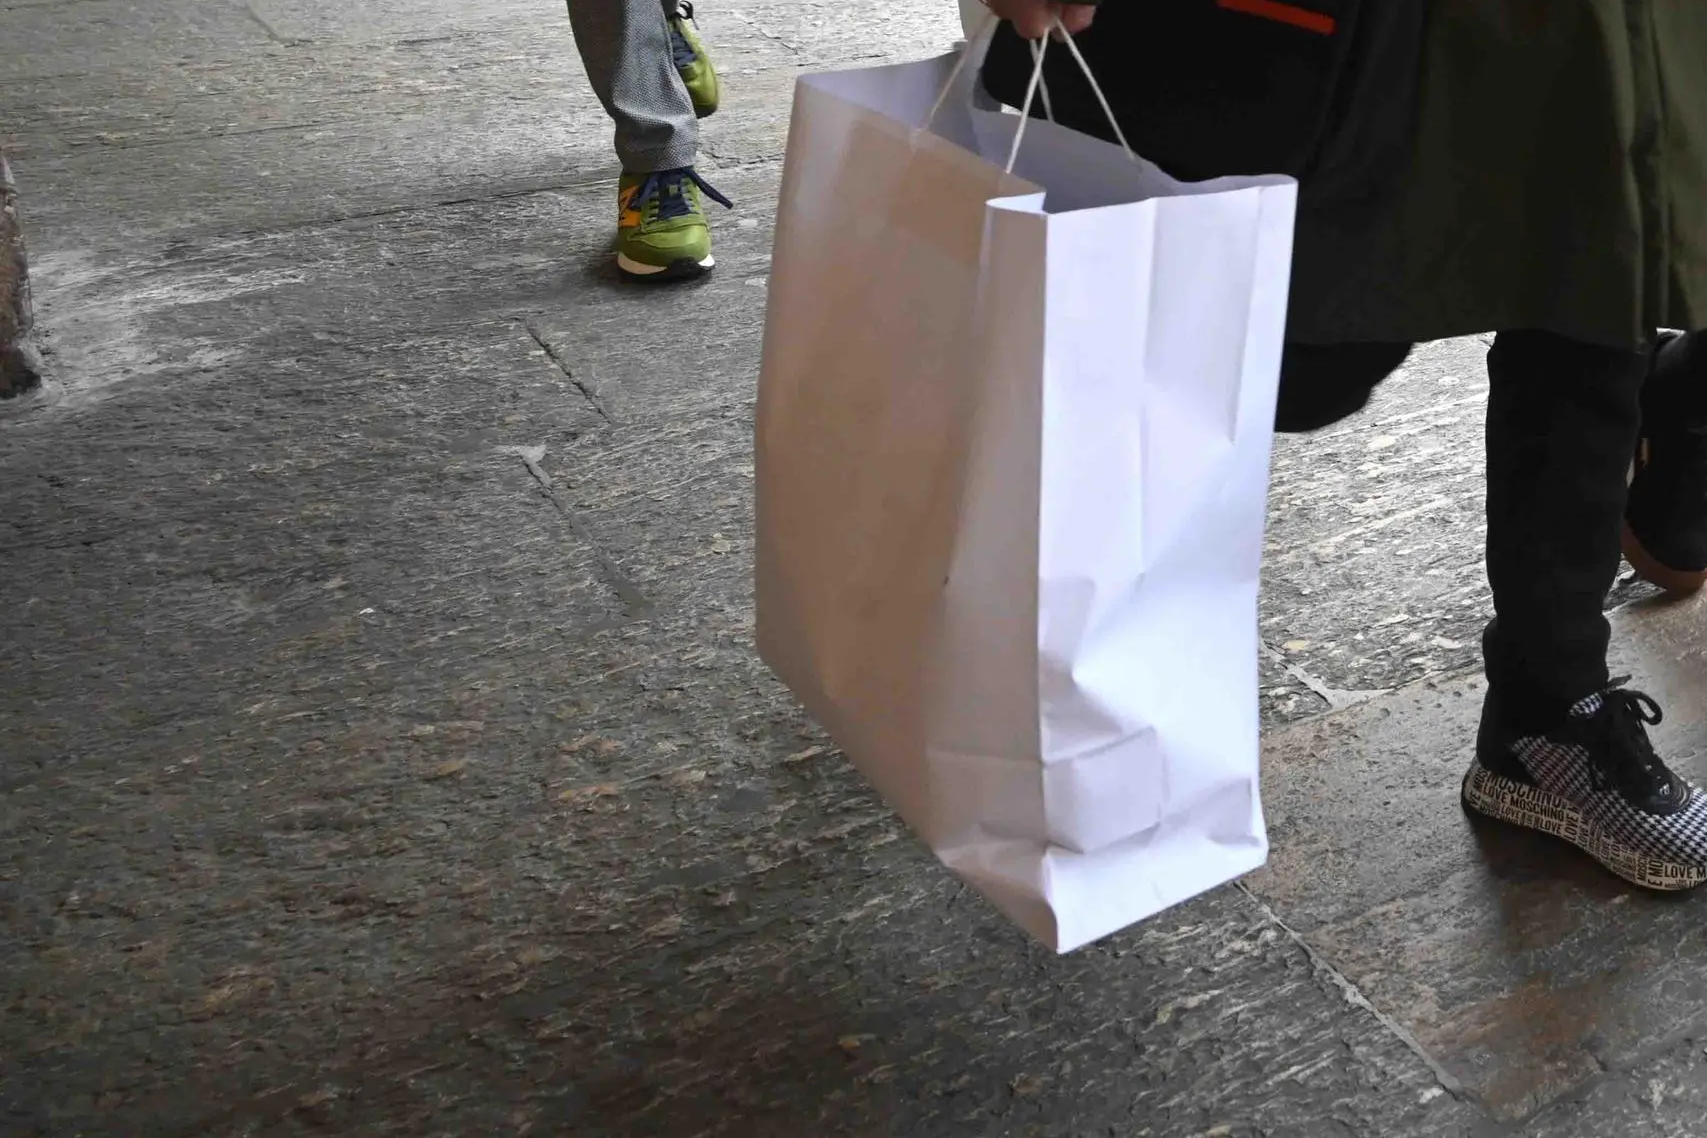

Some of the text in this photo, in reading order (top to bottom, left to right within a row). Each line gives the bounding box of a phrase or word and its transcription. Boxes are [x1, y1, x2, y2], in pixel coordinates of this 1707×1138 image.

[1484, 783, 1509, 803] LOVE
[1510, 794, 1565, 822] MOSCHINO
[1664, 865, 1693, 879] LOVE
